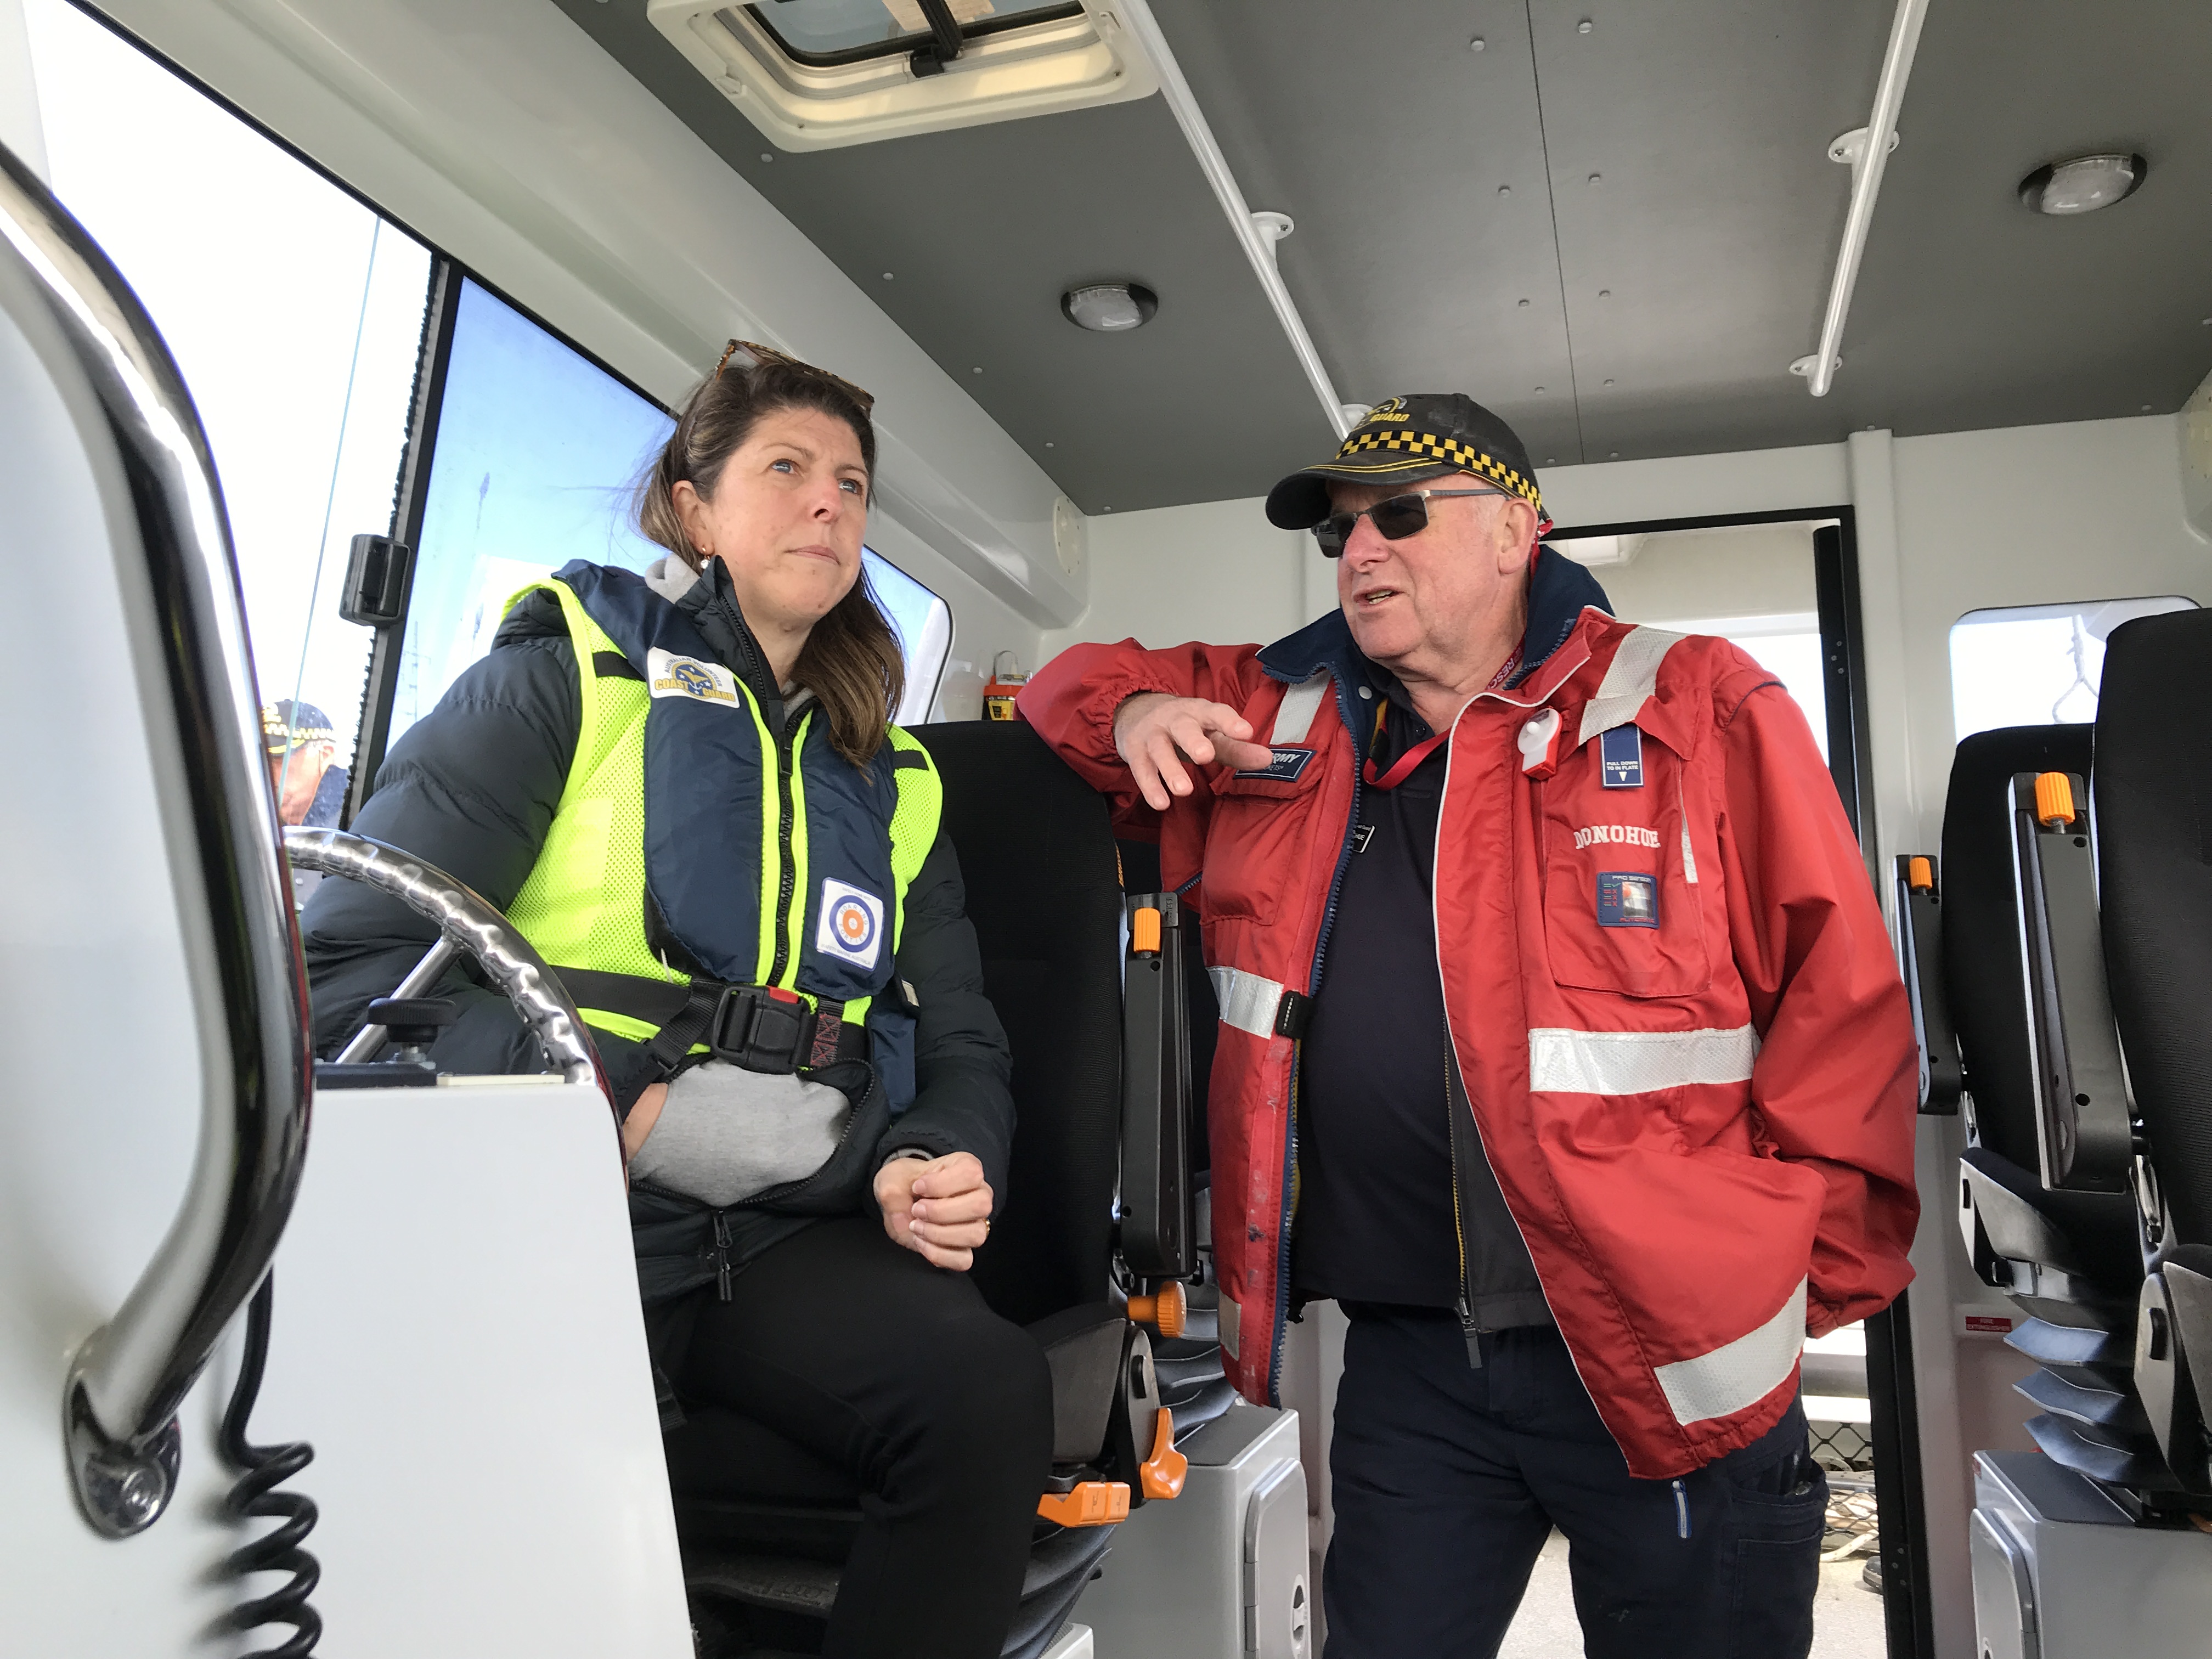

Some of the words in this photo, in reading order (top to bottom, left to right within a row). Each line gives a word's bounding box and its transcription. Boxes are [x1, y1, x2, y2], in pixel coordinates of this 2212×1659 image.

[664, 657, 691, 673] AUSTRALIAN
[693, 659, 723, 687] VOLUNTEER
[654, 678, 689, 691] COAST
[702, 687, 736, 702] GUARD
[1273, 753, 1301, 764] RMY
[1573, 825, 1661, 849] DONOHUE
[839, 904, 868, 926] ROARING
